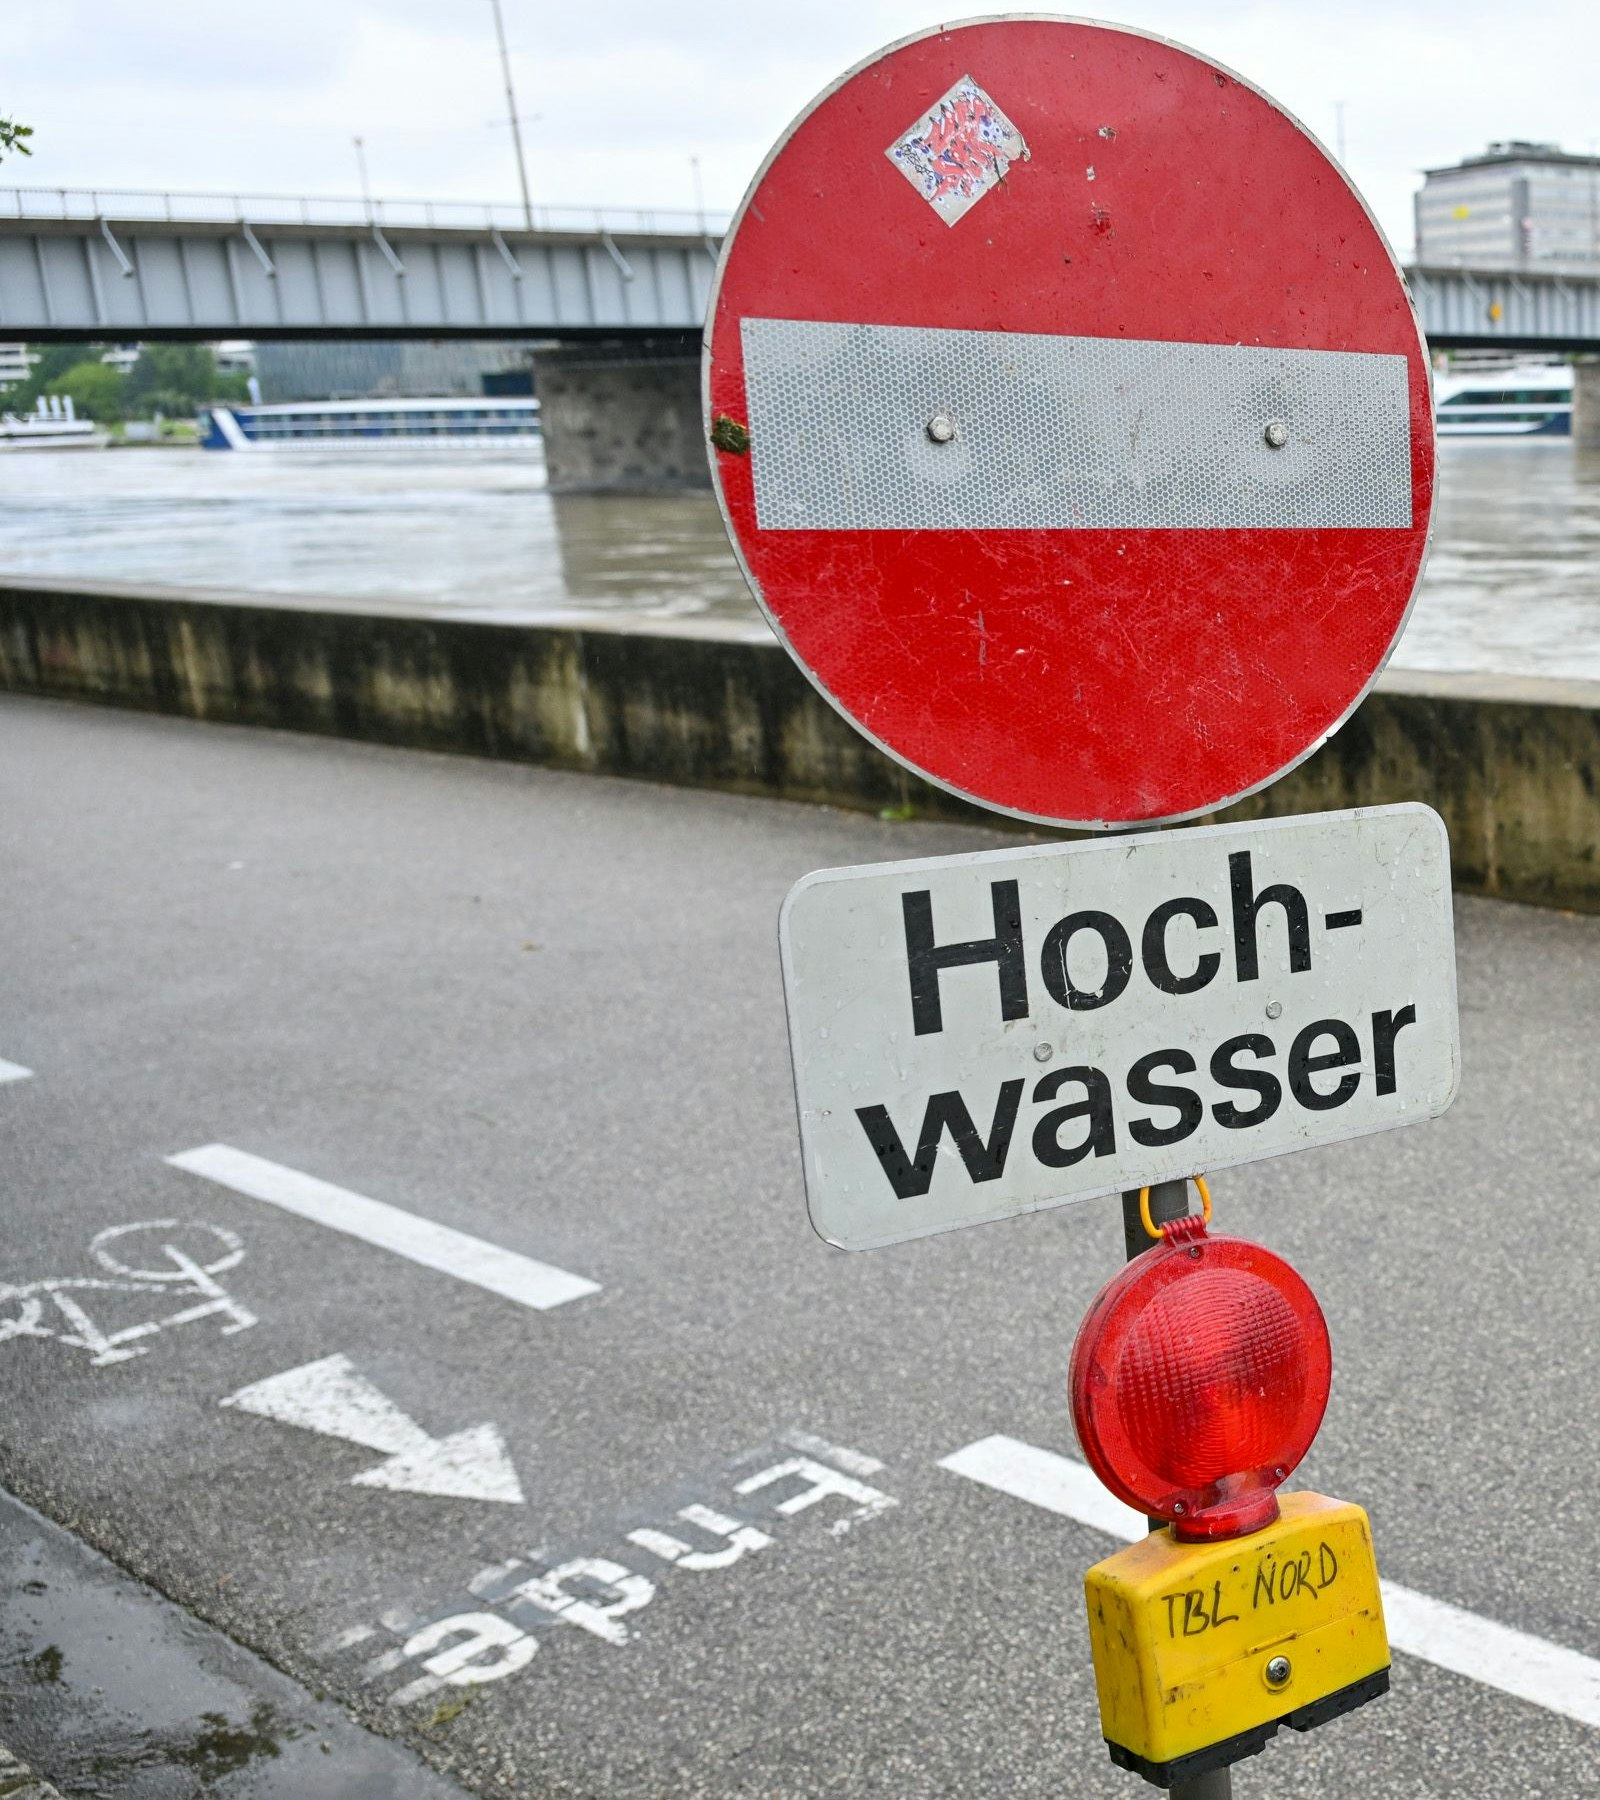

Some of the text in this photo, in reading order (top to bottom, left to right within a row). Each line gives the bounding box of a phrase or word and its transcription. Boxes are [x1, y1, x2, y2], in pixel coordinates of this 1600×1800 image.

[901, 850, 1363, 1037] Hoch-
[854, 1003, 1417, 1200] wasser
[386, 1436, 900, 1706] Ende
[1160, 1541, 1338, 1639] TBL NORD
